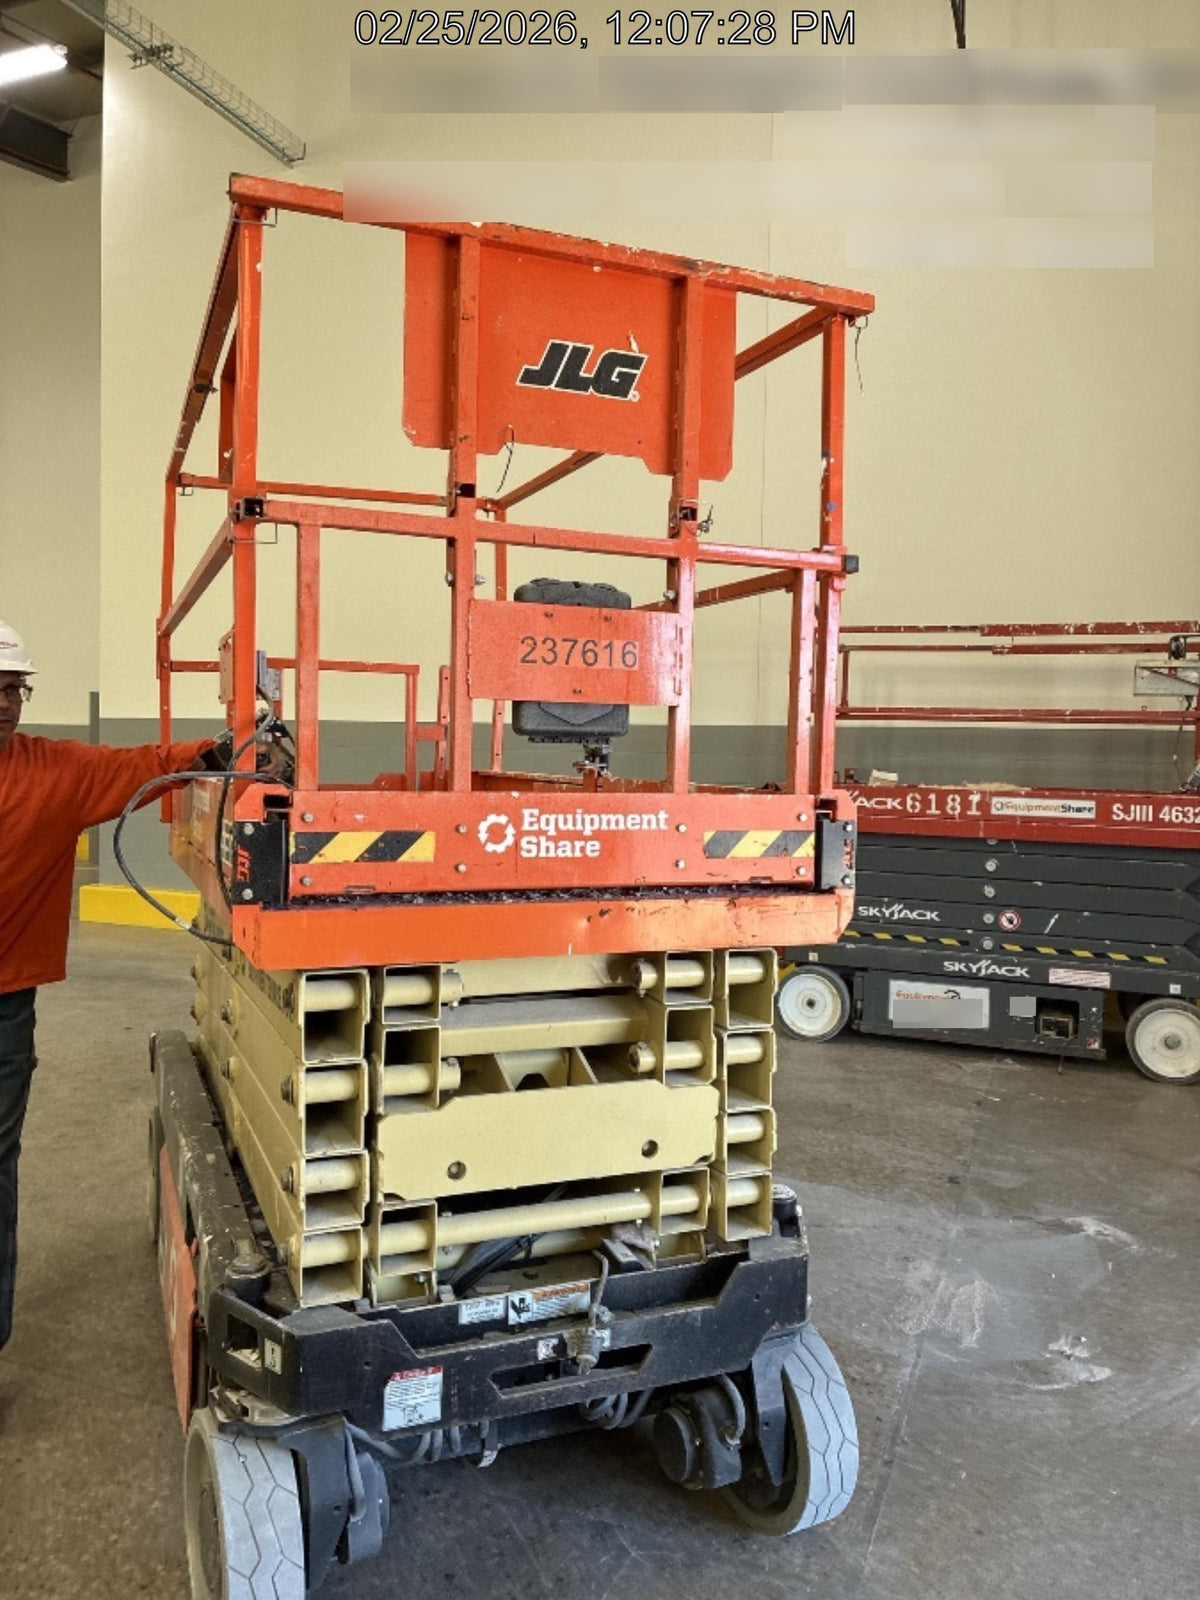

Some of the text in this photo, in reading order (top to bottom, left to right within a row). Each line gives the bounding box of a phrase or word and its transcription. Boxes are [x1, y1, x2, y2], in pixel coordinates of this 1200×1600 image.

[516, 339, 649, 401] JLG
[520, 636, 638, 668] 237616
[521, 808, 669, 836] Equipment
[1112, 803, 1153, 822] SJIII
[520, 835, 601, 858] Share
[857, 903, 941, 922] SKYJACK
[943, 959, 1031, 978] SKYJACK
